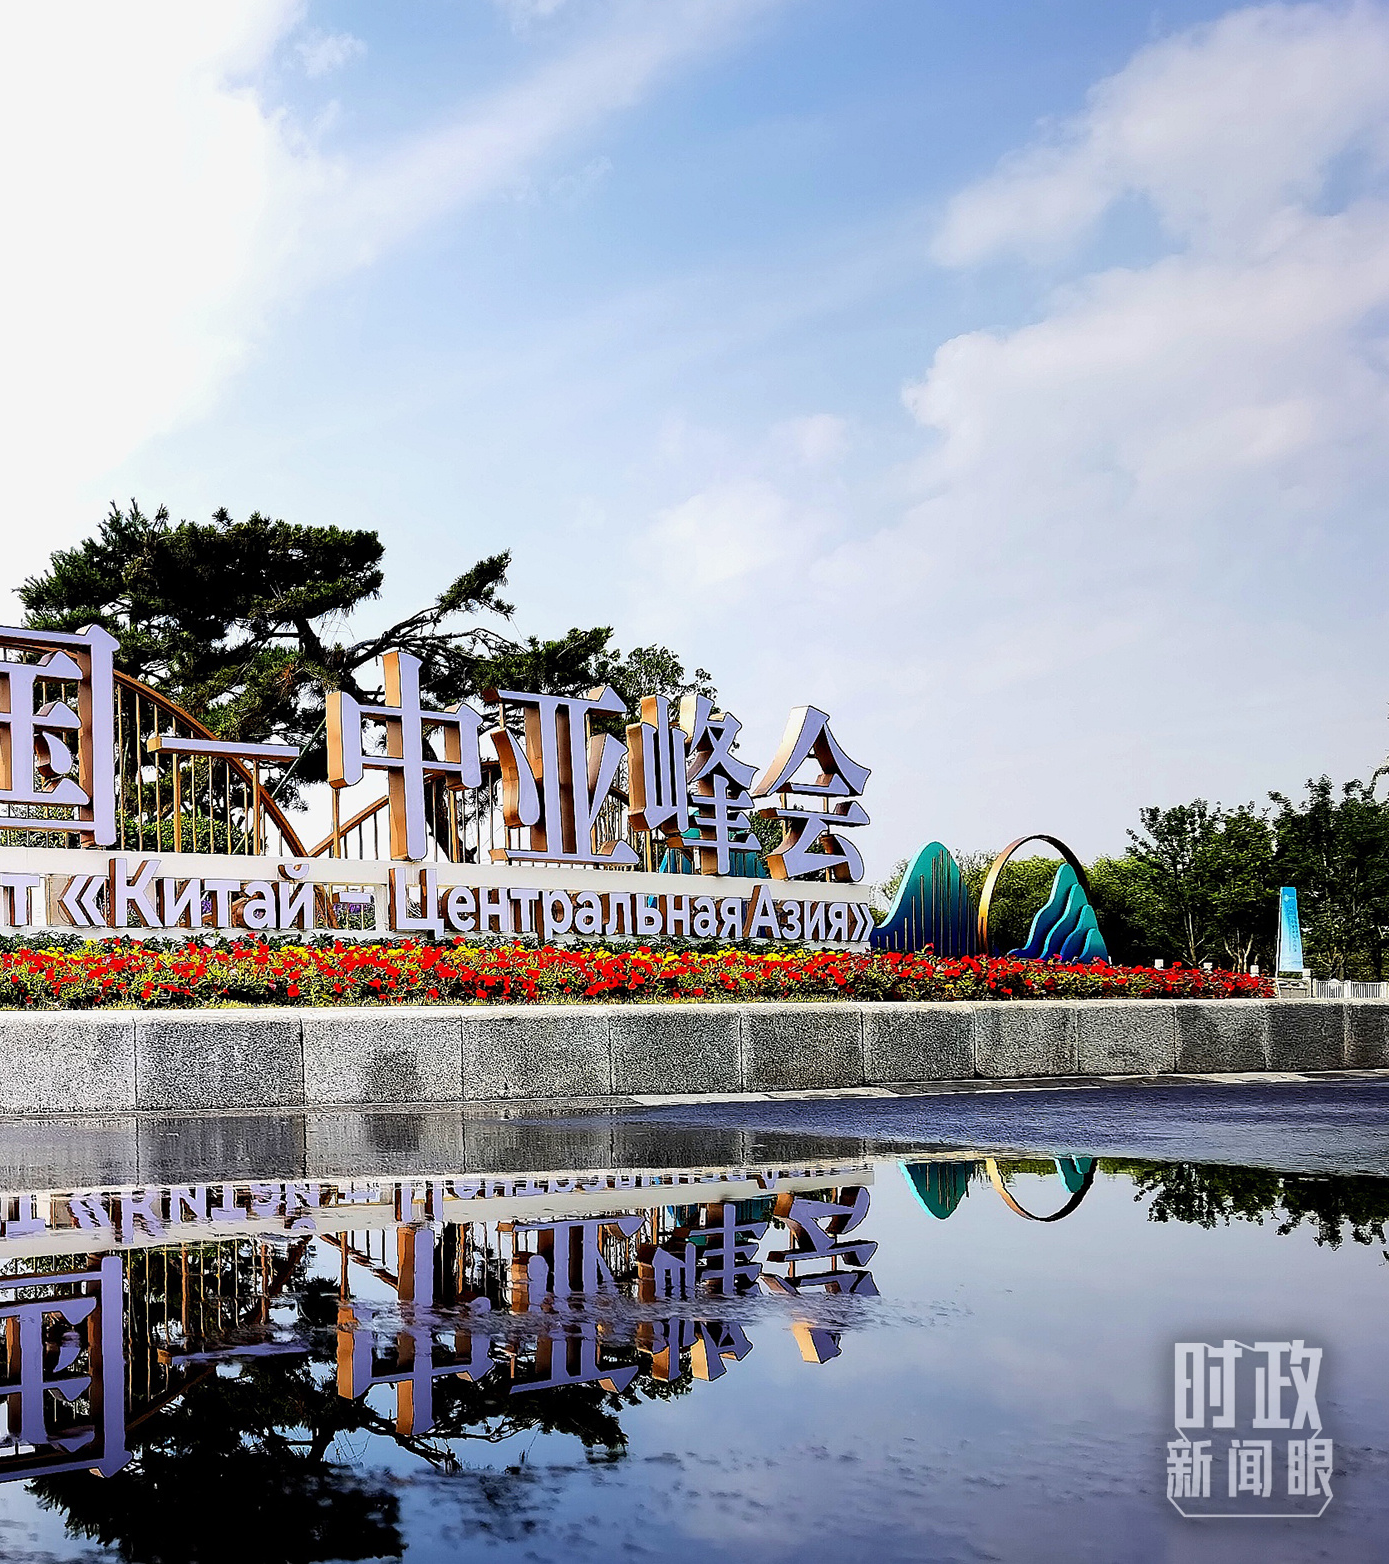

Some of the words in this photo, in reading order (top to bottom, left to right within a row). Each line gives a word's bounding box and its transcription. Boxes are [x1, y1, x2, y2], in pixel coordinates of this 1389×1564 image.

[57, 857, 314, 930] «Китай
[388, 868, 743, 940] Центральная
[748, 884, 874, 941] Азия»
